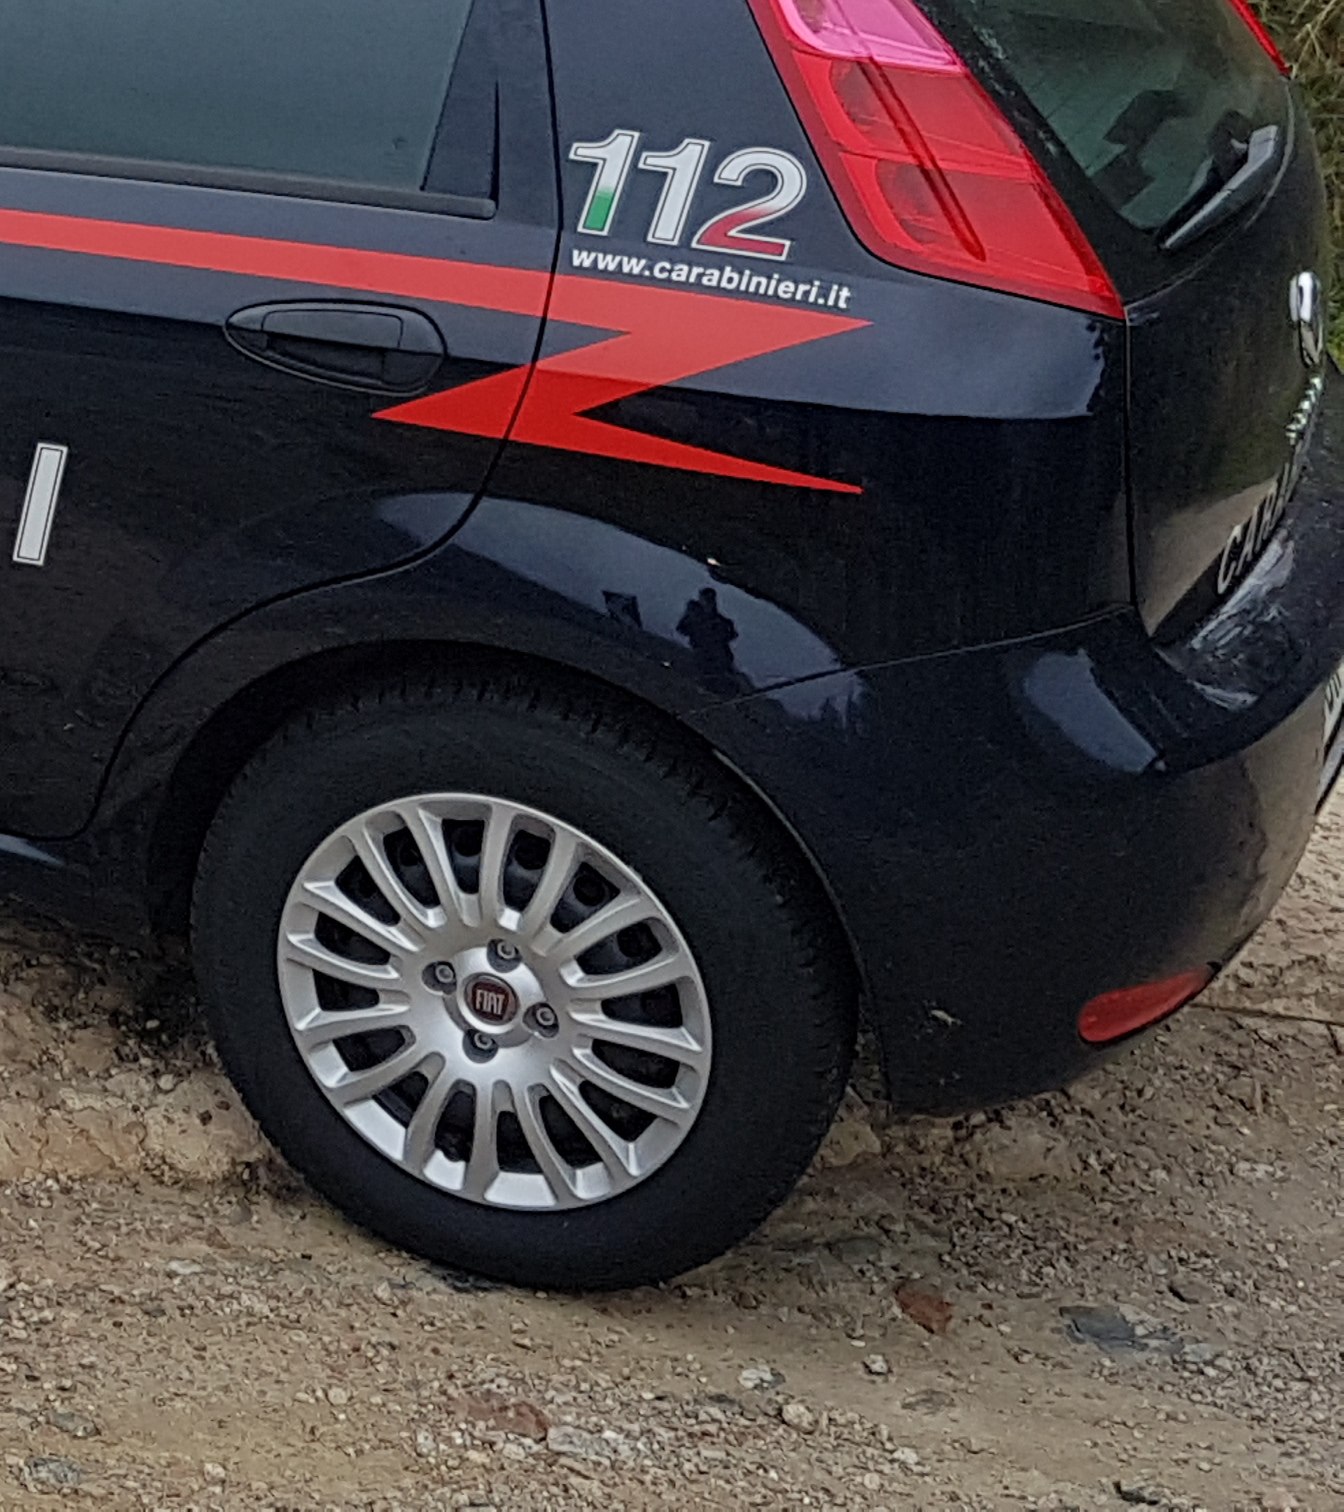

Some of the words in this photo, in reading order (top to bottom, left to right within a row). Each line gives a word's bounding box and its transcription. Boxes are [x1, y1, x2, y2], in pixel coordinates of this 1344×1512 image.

[569, 129, 807, 262] 112
[570, 248, 852, 309] www.carabinieri.it
[475, 988, 506, 1015] FIAT
